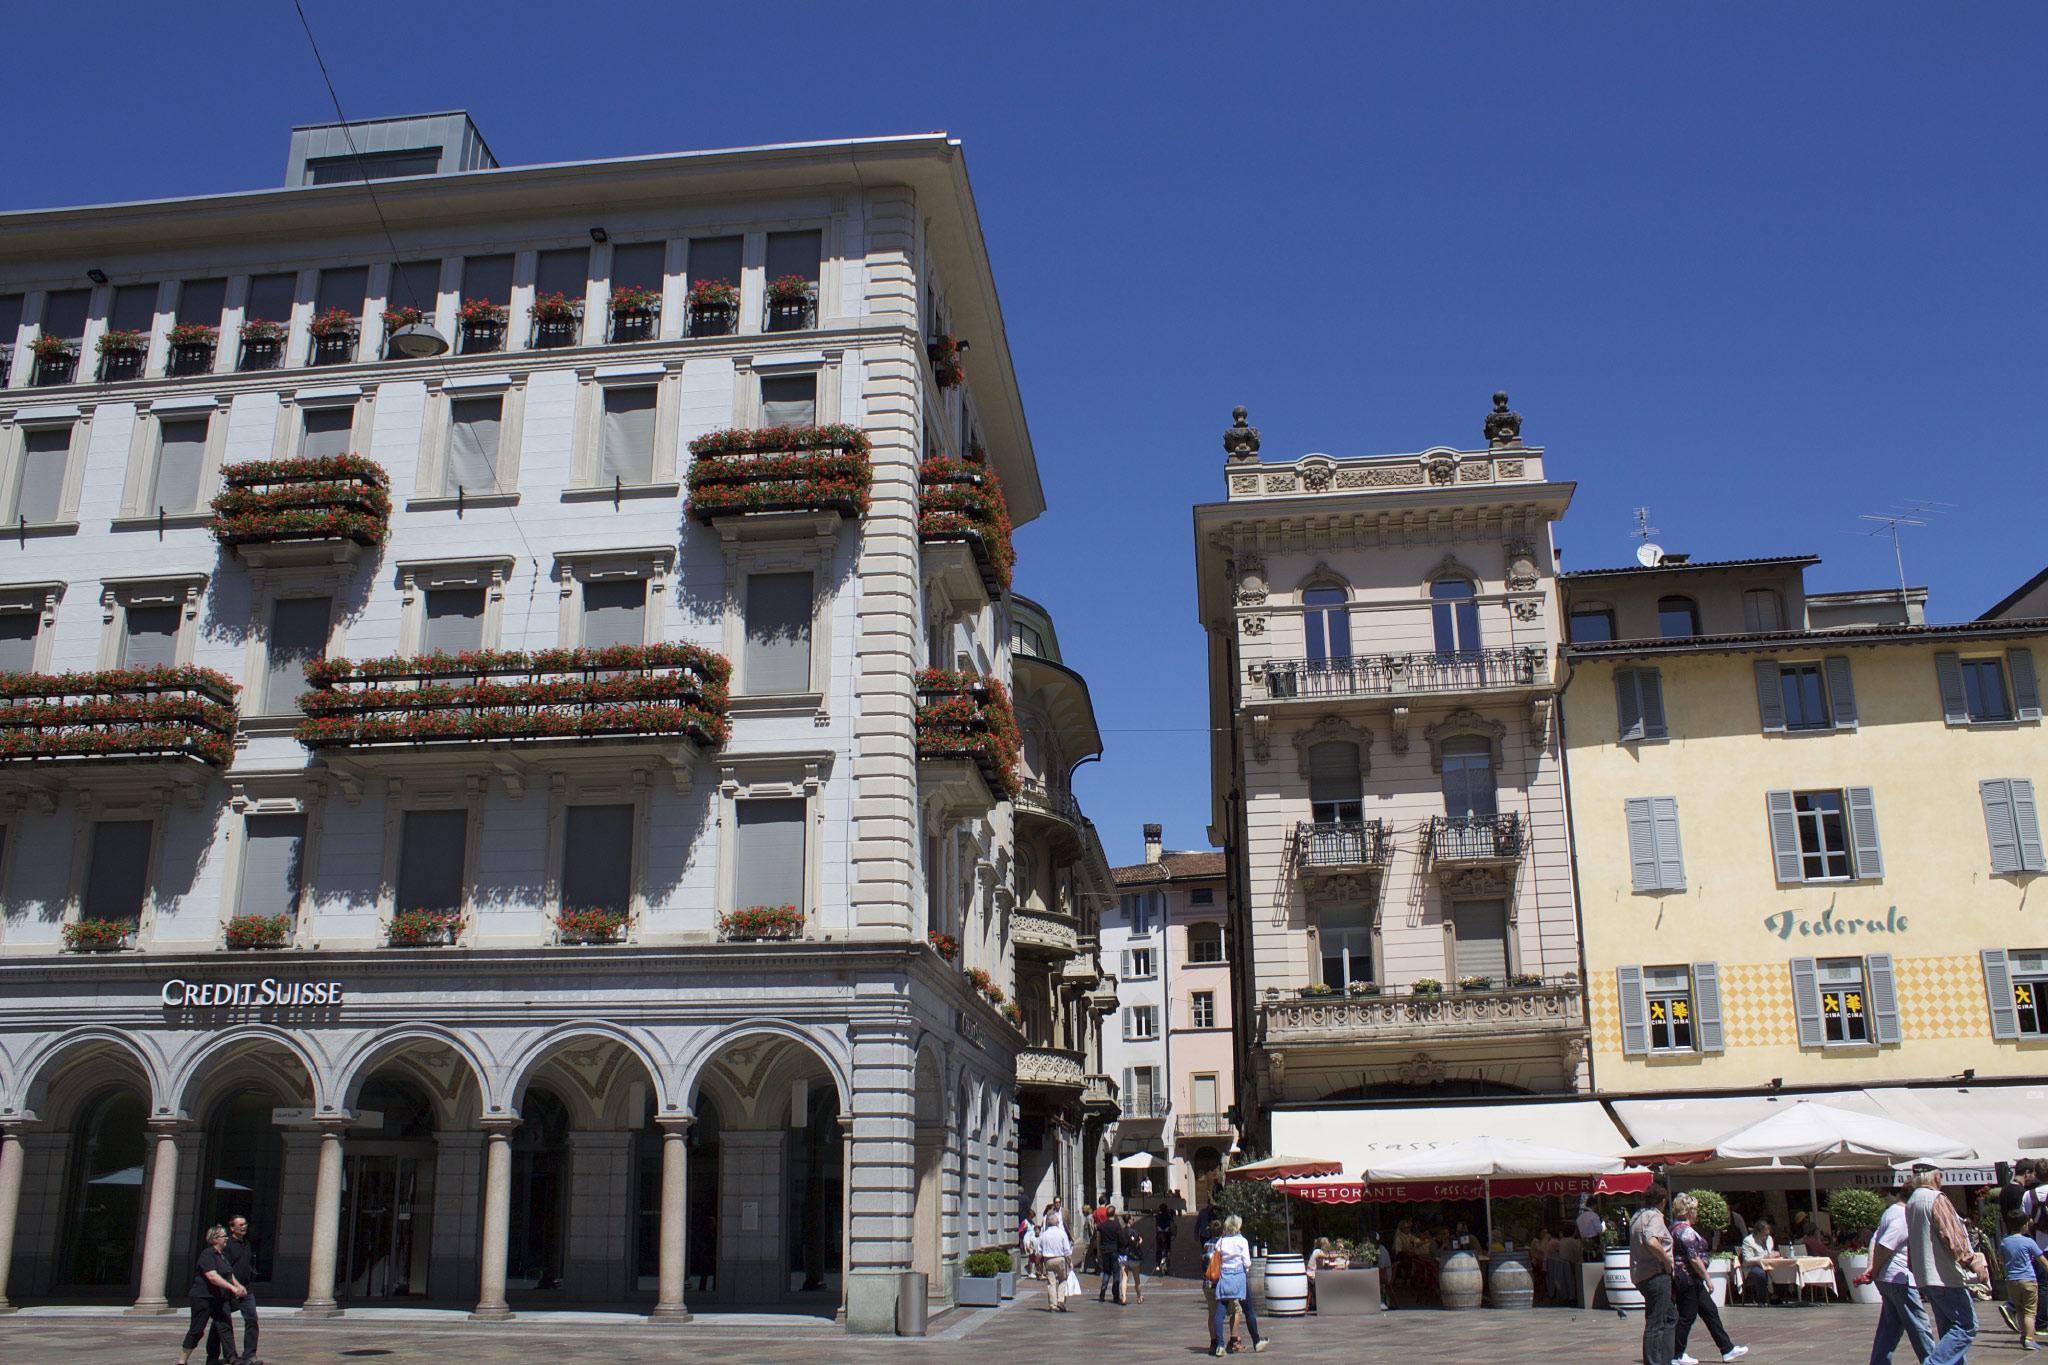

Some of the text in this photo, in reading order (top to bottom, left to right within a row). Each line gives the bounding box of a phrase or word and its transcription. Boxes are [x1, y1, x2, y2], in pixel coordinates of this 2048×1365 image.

[1764, 906, 1909, 939] Federale
[162, 978, 342, 1006] CREDIT SUISSE
[1300, 1187, 1407, 1199] RISTORANTE
[1535, 1179, 1608, 1191] VINERIA
